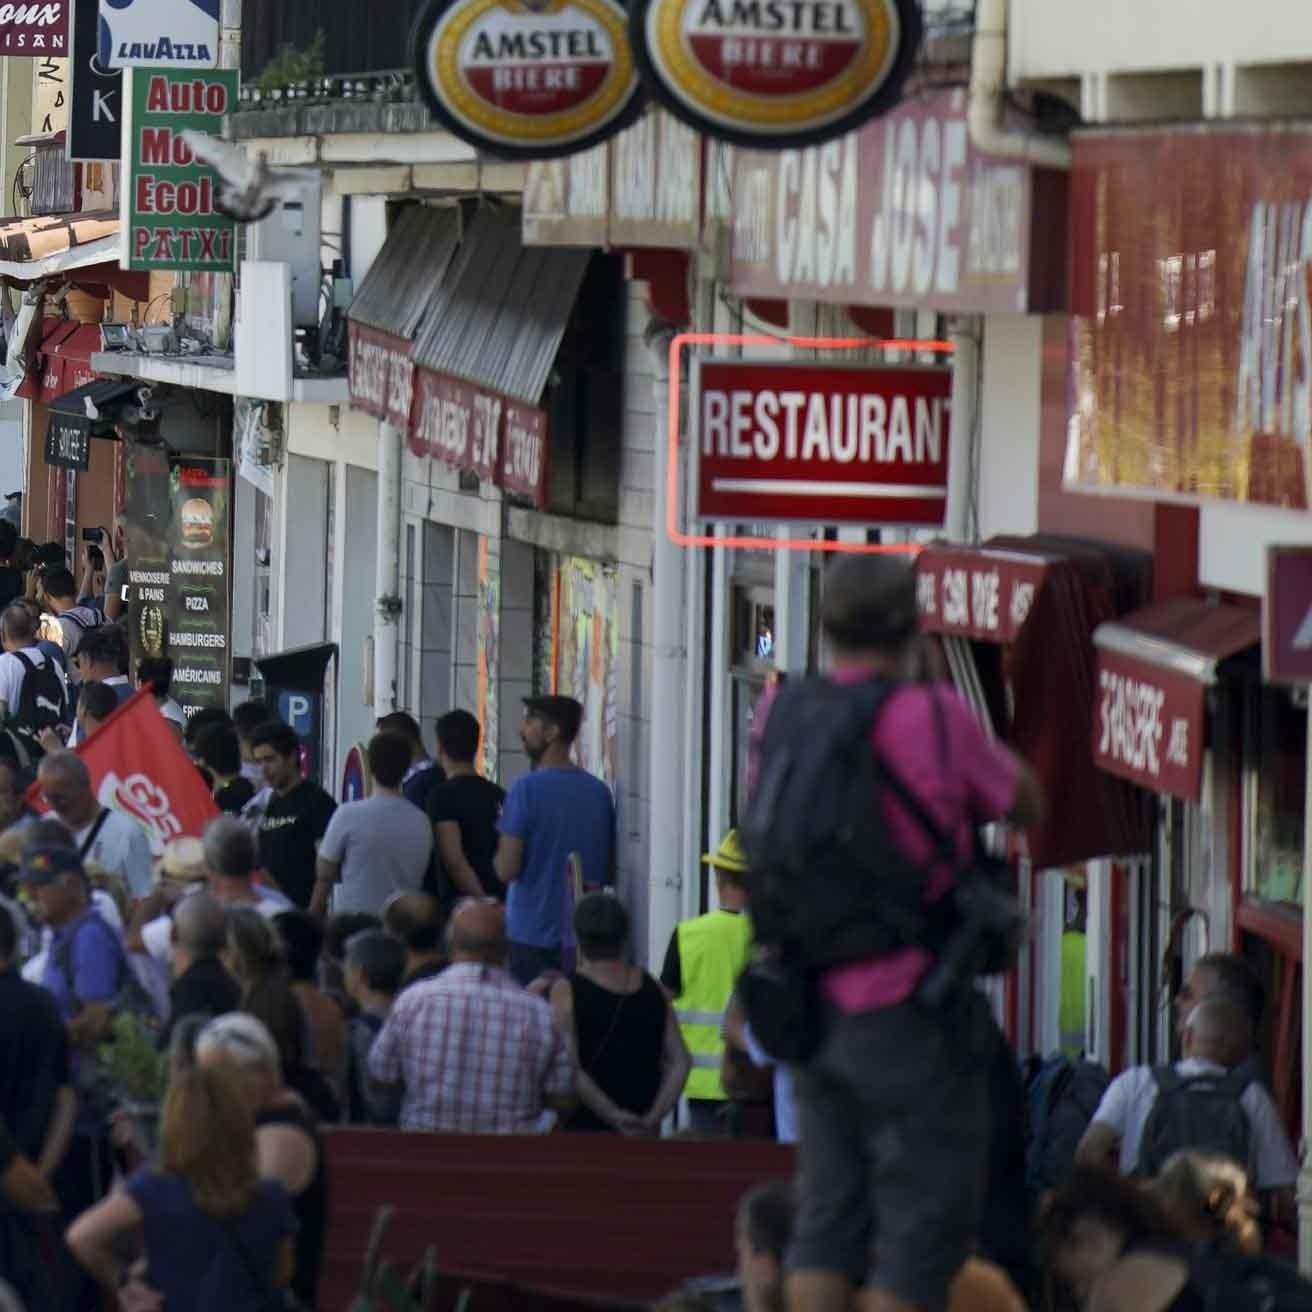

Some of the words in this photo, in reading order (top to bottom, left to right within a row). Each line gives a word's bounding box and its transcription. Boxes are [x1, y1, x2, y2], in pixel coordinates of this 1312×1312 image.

[117, 36, 211, 61] LAVAZZA
[472, 29, 604, 61] AMSTEL
[721, 40, 823, 69] BIERE
[492, 66, 580, 92] BIERE
[147, 76, 227, 113] Auto
[140, 128, 208, 166] Mo
[135, 174, 218, 214] Ecol
[776, 136, 858, 286] CASA
[132, 226, 232, 262] PATXI
[703, 388, 953, 468] RESTAURAN
[172, 559, 224, 576] SANDWICHES
[145, 588, 164, 601] PAINS
[185, 596, 209, 611] PIZZA
[169, 632, 225, 649] HAMBURGERS
[172, 667, 223, 684] AMÉRICAINS
[288, 696, 309, 727] P
